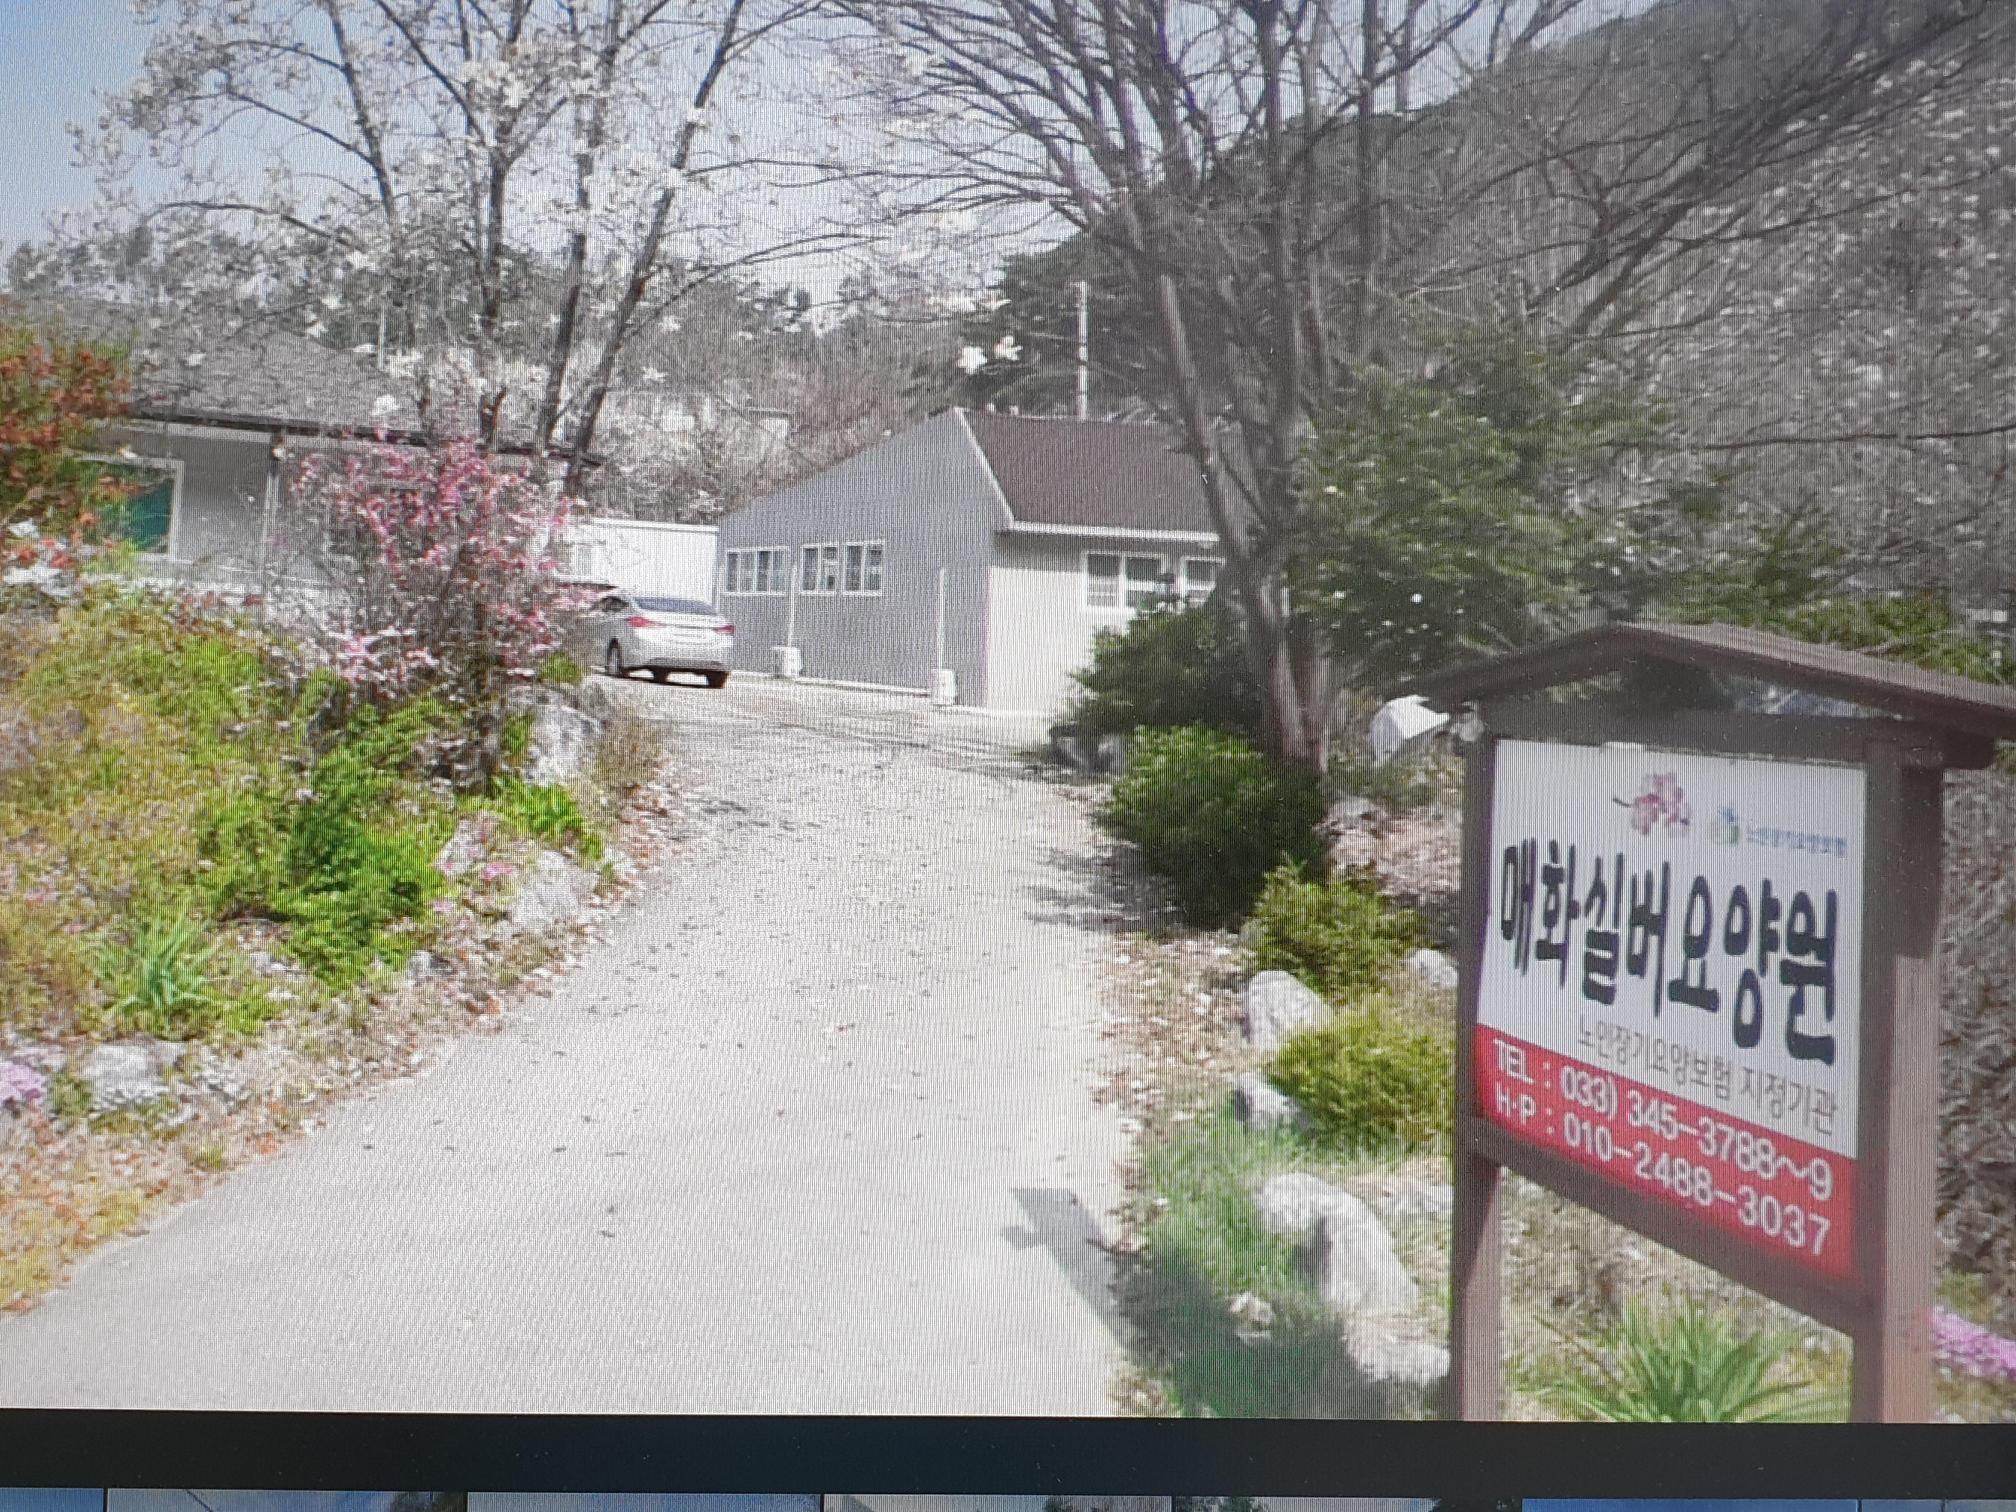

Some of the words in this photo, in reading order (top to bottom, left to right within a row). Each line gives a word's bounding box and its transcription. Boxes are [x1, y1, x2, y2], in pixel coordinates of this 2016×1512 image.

[1501, 838, 1837, 1066] 매화실버요양원
[1578, 1015, 1733, 1101] 노인장기요양보험
[1742, 1067, 1837, 1135] 지정기관
[1564, 1112, 1831, 1256] 010-2488-3037
